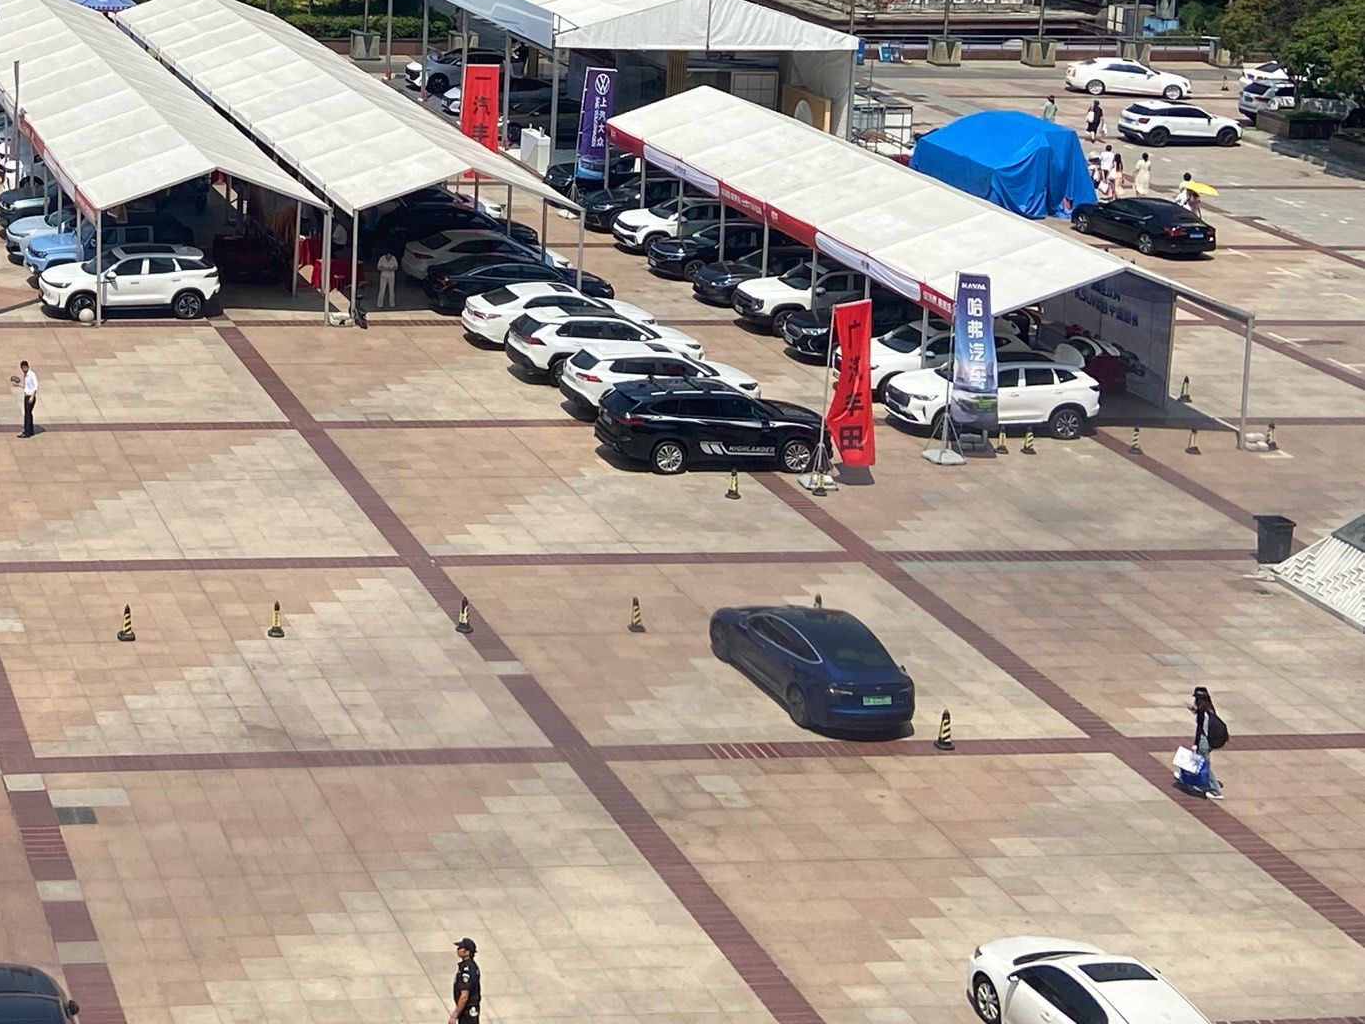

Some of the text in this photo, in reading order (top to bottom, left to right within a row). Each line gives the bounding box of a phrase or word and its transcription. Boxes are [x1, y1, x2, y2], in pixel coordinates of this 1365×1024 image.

[596, 96, 608, 147] 上汽大众
[728, 446, 776, 454] HIGHLANDER
